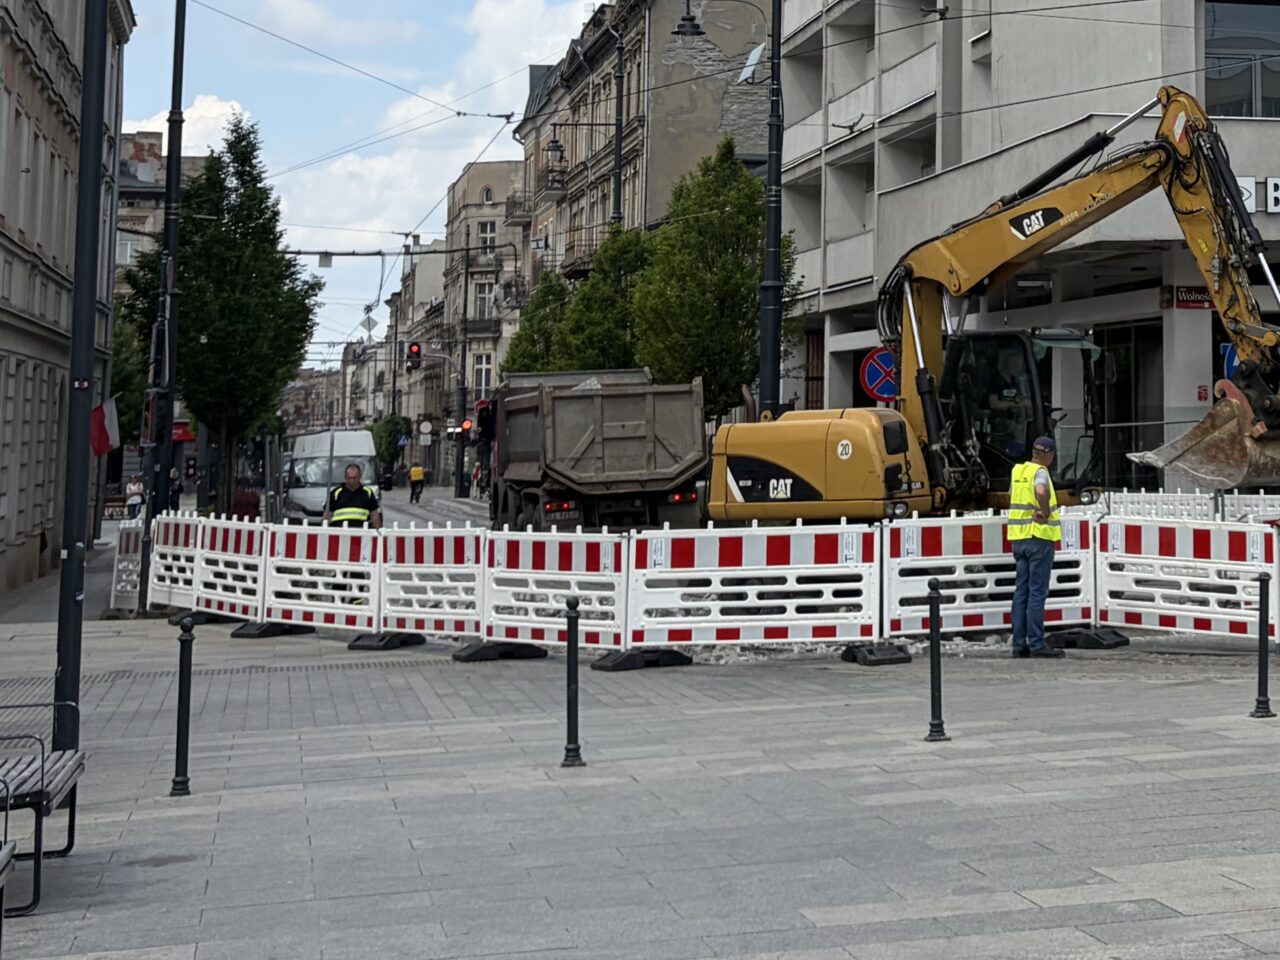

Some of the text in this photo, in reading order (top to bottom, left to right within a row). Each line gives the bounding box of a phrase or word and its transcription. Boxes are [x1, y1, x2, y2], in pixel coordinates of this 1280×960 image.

[1022, 210, 1046, 236] CAT
[839, 443, 850, 457] 20
[769, 478, 793, 499] CAT
